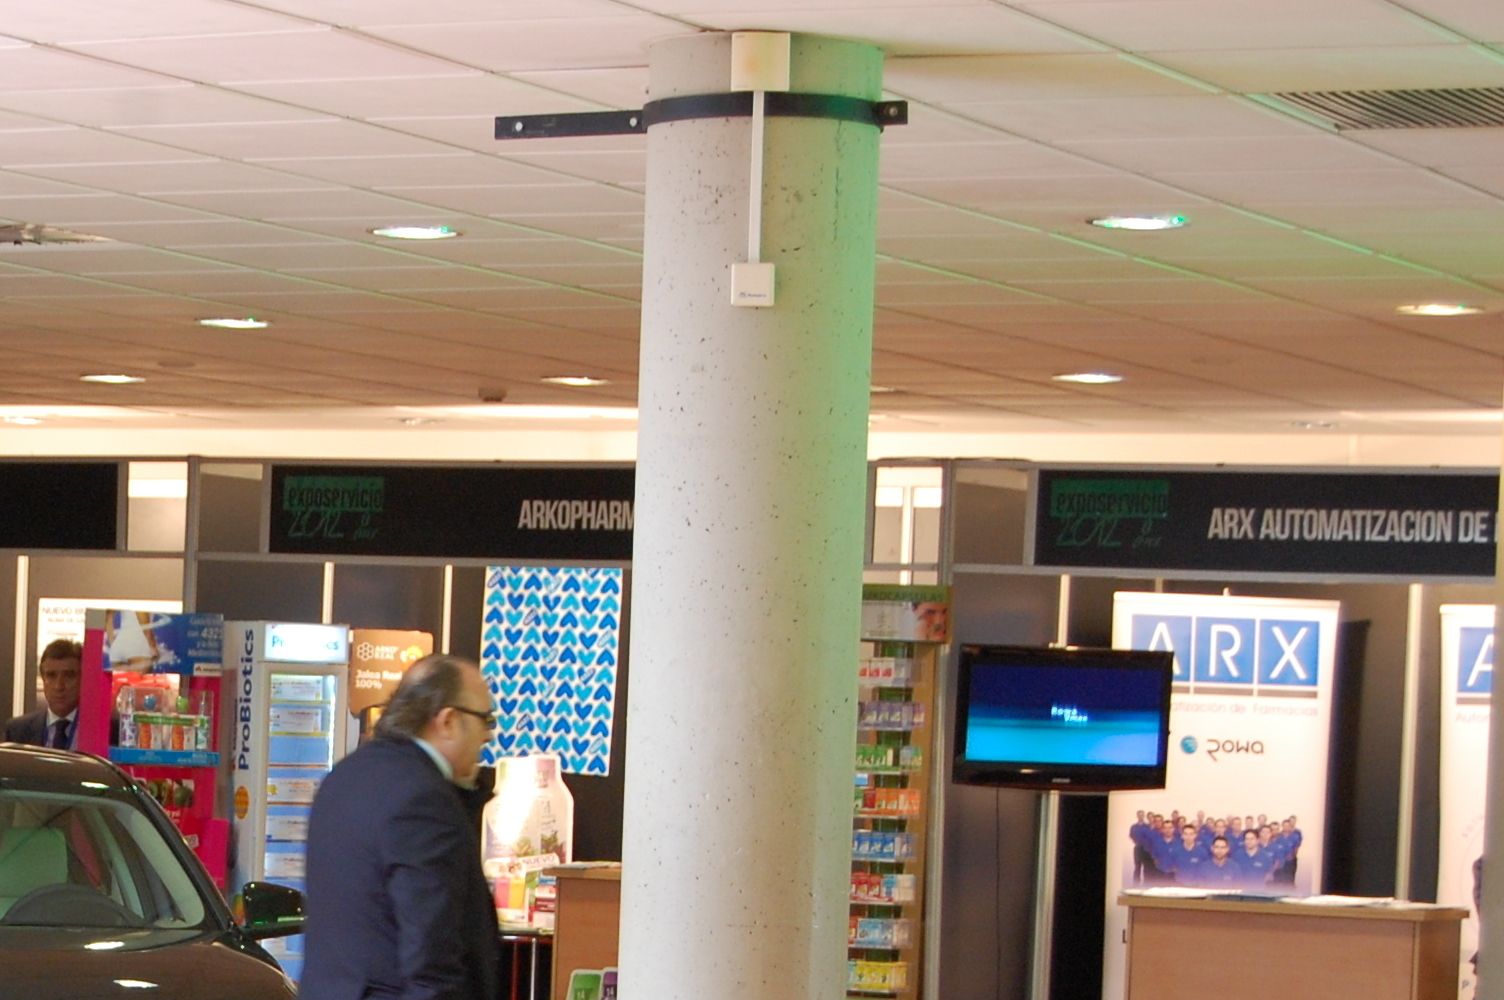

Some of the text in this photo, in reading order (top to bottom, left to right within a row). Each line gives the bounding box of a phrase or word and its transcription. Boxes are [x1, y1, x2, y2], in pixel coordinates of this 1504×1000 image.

[1207, 507, 1256, 540] ARX
[1259, 509, 1452, 543] AUTOMATIZACION
[1457, 511, 1489, 543] DE
[1148, 622, 1308, 681] ARX
[237, 628, 255, 771] ProBiotics
